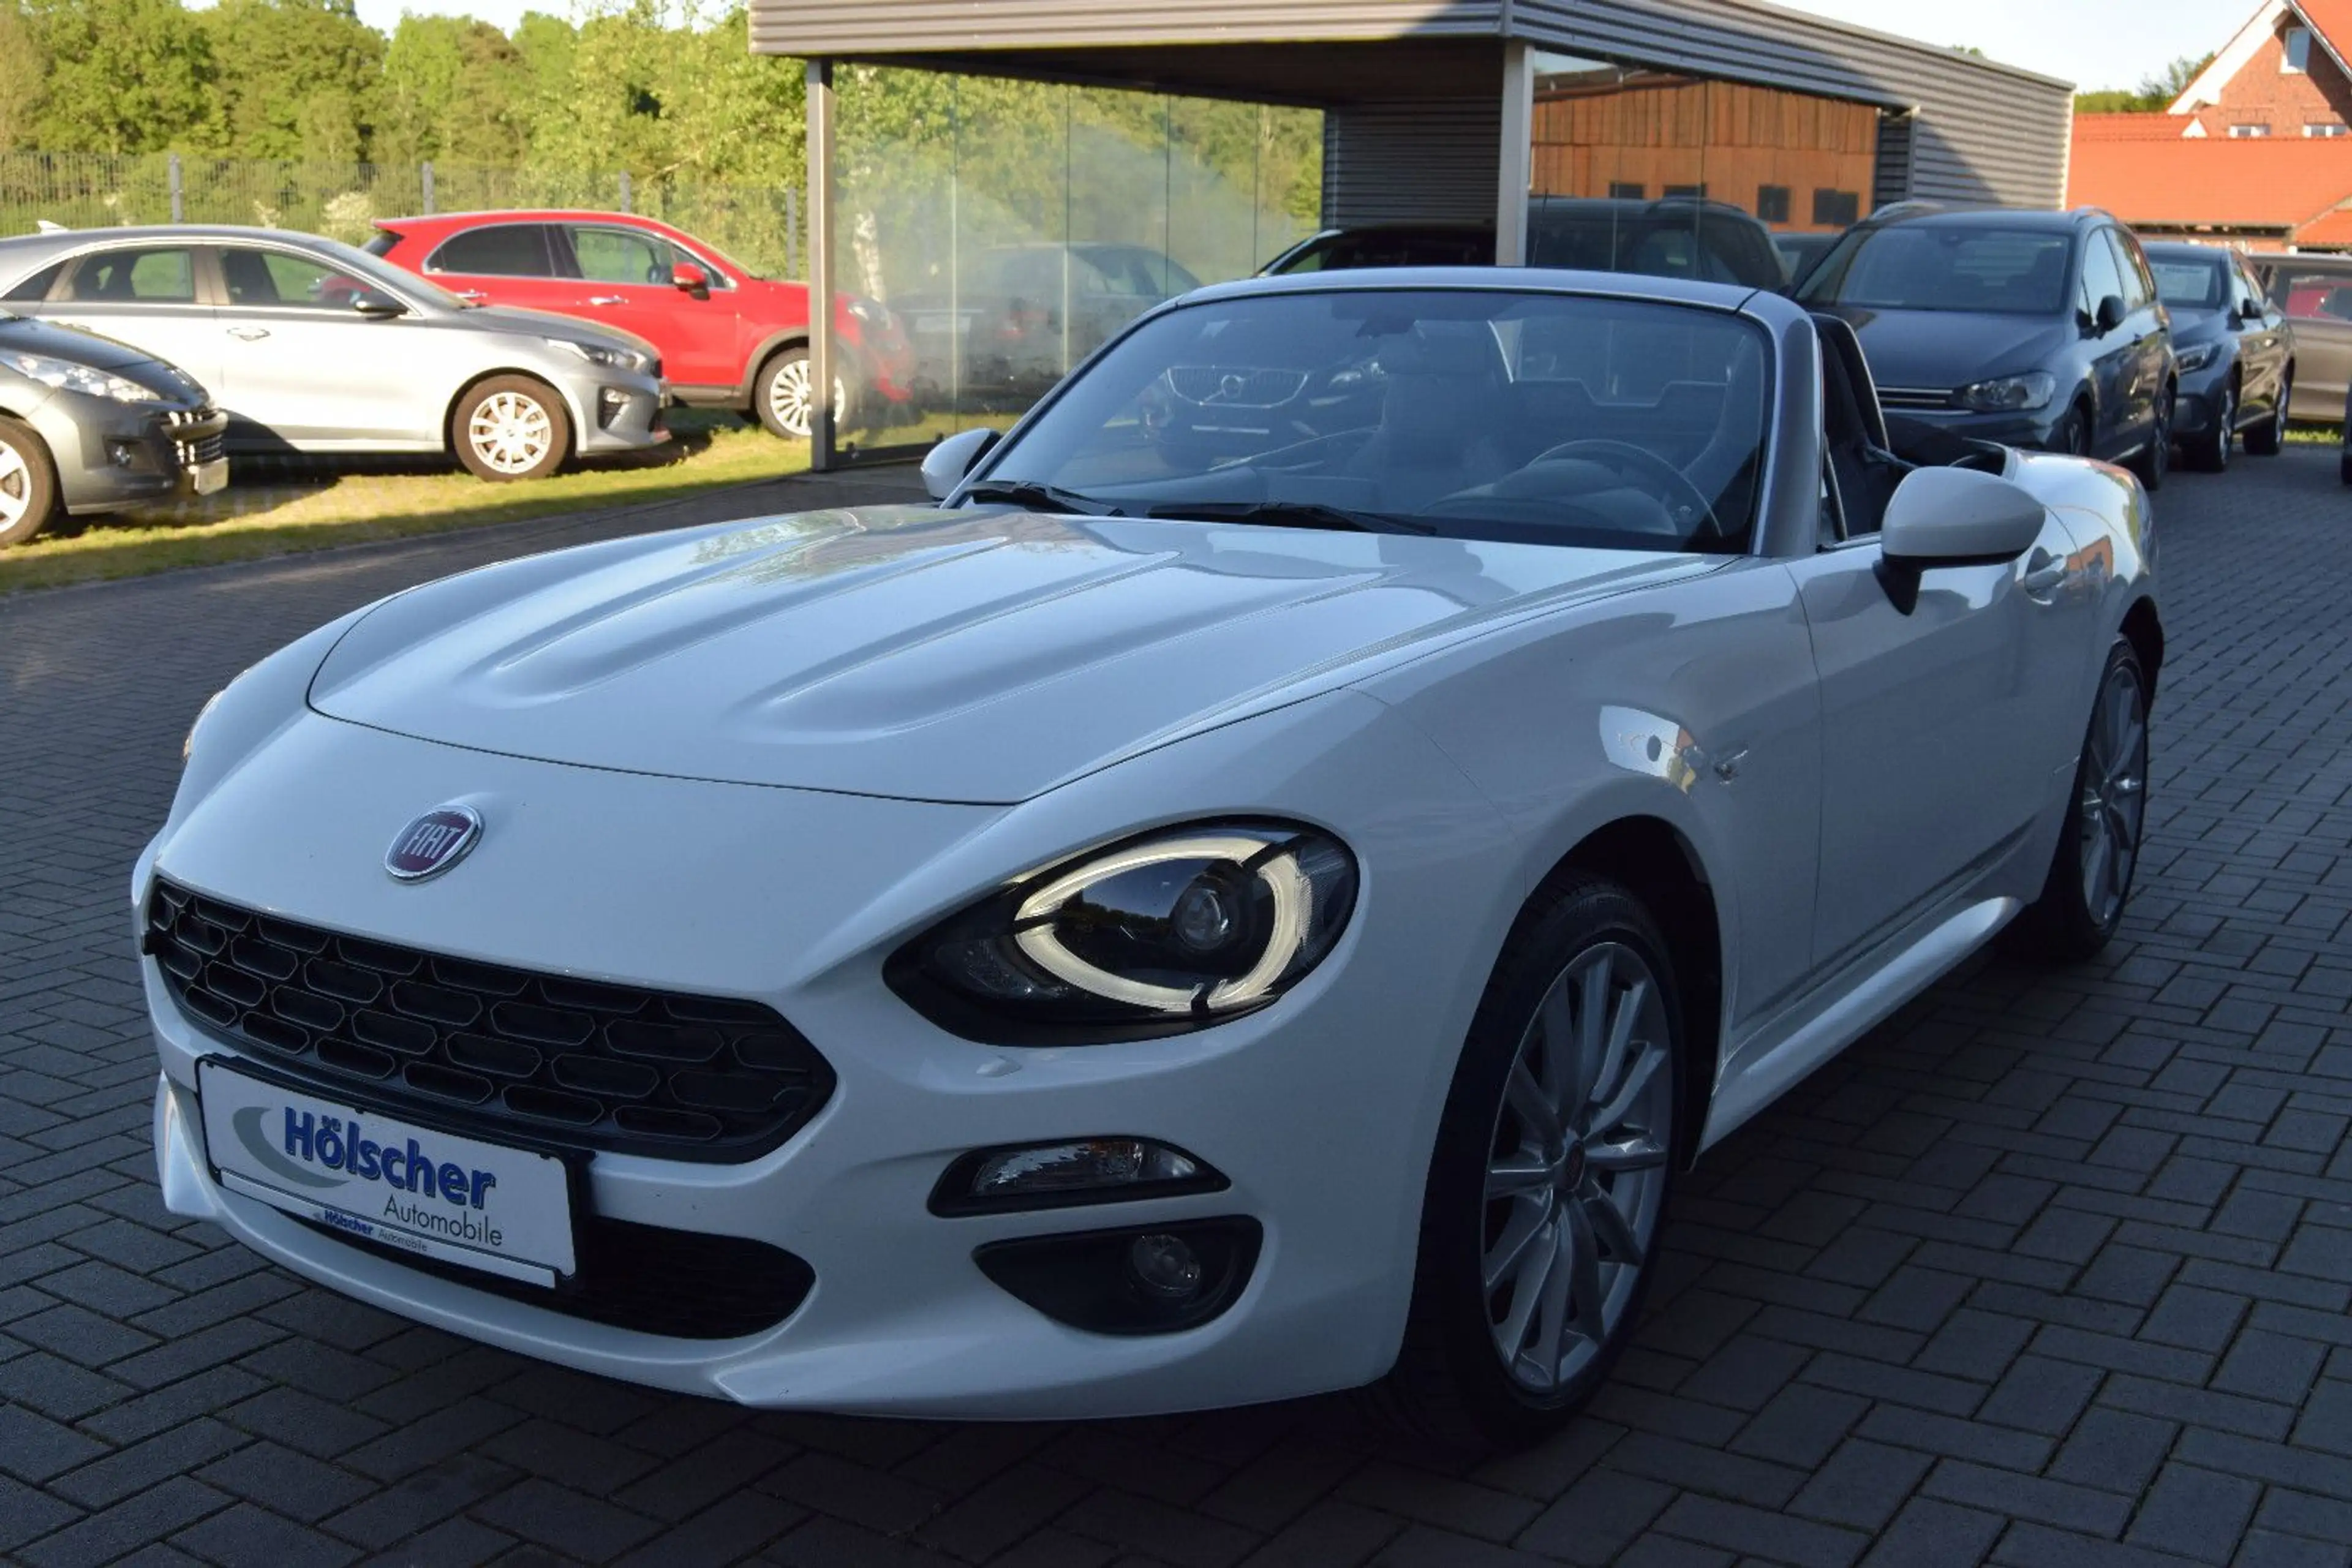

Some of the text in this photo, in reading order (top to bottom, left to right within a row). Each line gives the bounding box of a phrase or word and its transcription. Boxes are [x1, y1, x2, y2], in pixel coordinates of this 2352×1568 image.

[401, 823, 462, 859] FIAT
[285, 1106, 496, 1210] Hölscher
[383, 1193, 503, 1246] Automobile
